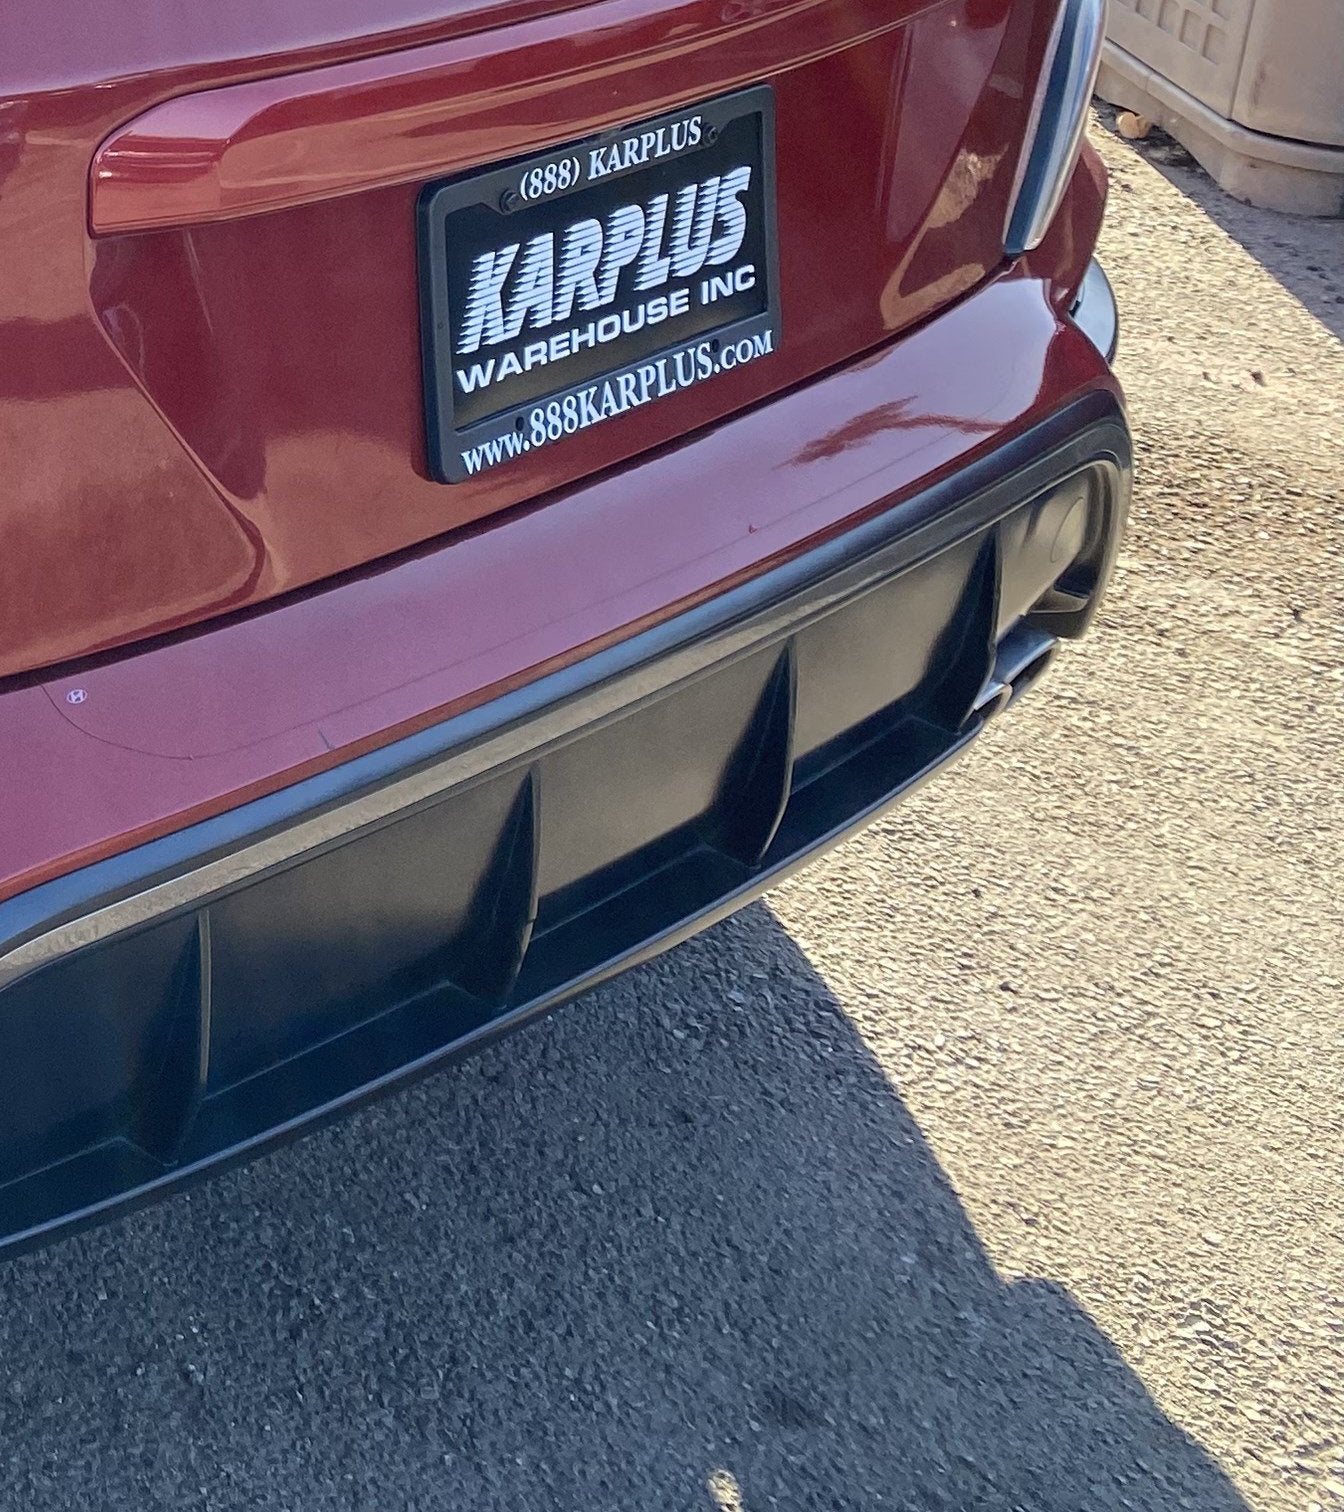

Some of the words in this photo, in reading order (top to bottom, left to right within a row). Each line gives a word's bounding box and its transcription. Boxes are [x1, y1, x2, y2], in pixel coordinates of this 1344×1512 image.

[519, 157, 581, 201] (888)
[587, 115, 702, 181] KARPLUS
[456, 166, 752, 355] KARPLUS
[456, 287, 690, 395] WAREHOUSE
[701, 264, 756, 305] INC
